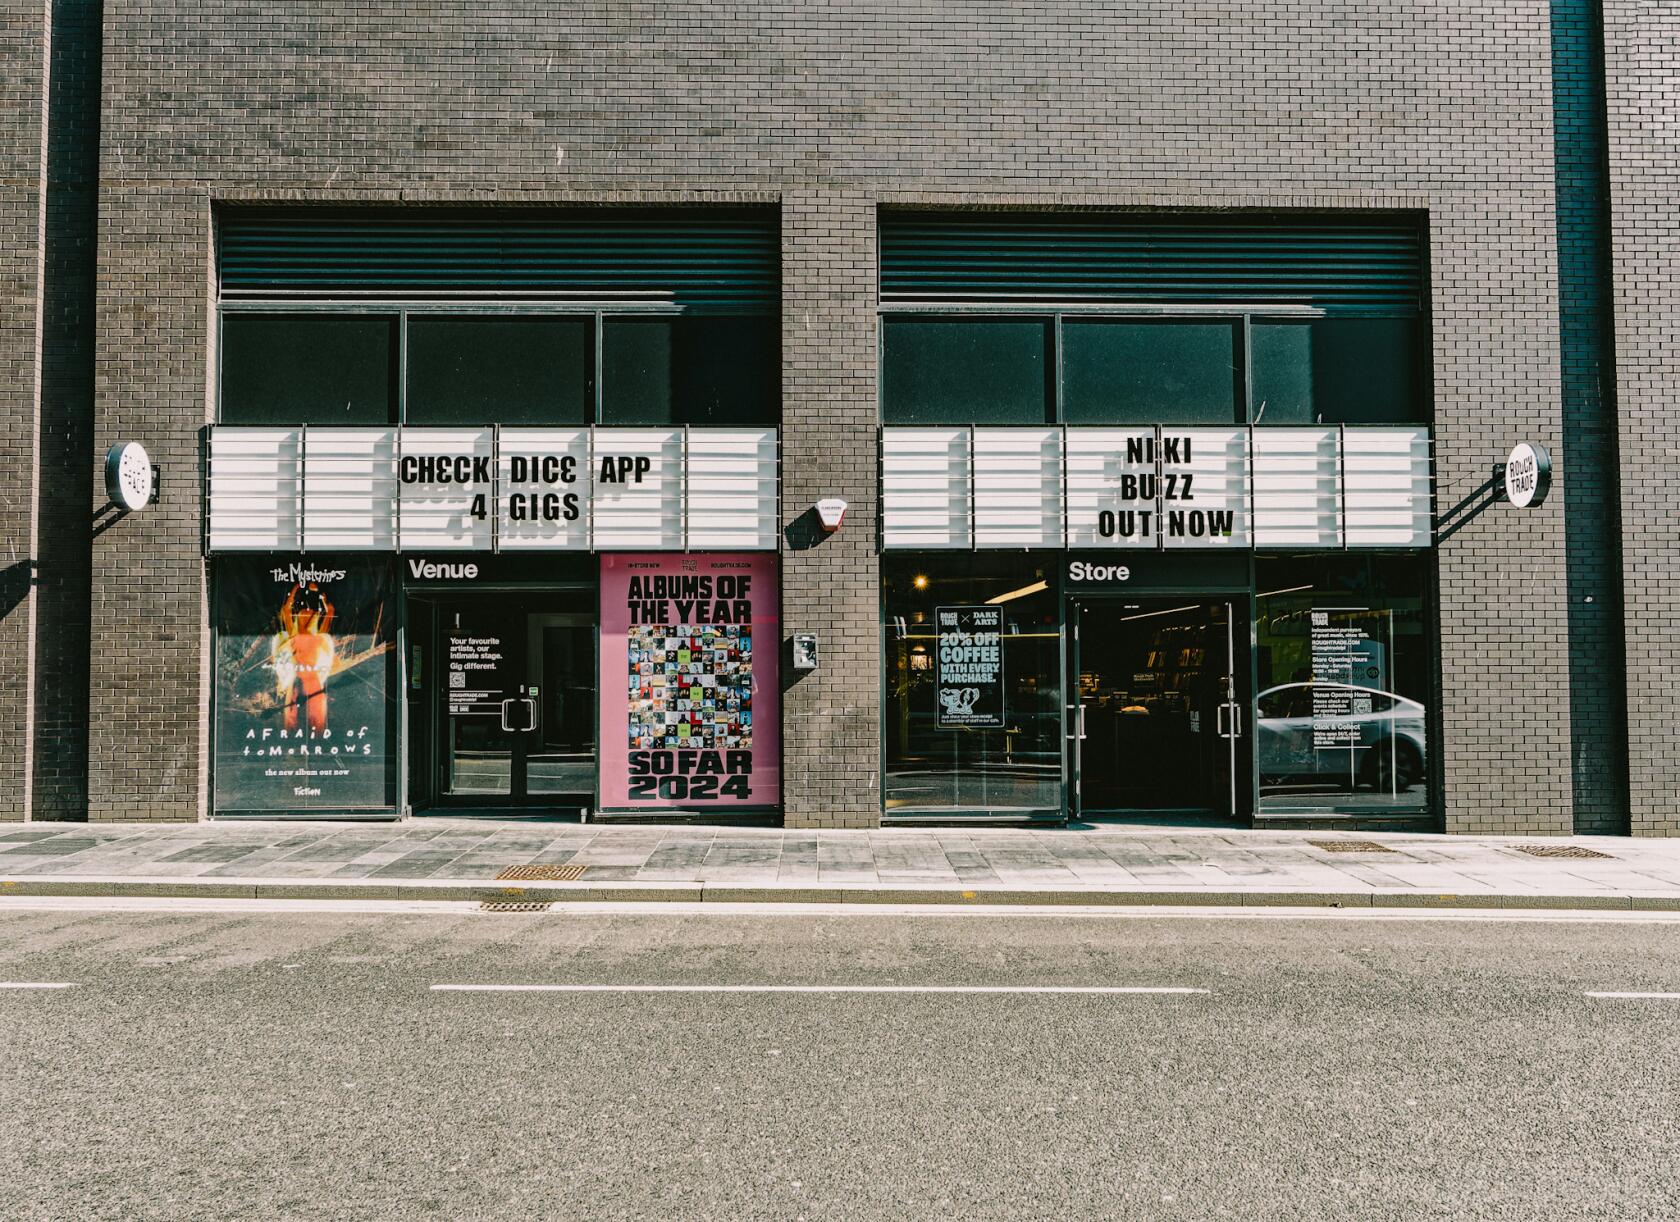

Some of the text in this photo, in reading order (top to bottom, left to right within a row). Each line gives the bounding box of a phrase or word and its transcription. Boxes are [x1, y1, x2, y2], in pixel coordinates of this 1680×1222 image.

[1127, 438, 1191, 463] NIKI
[401, 456, 650, 483] CHECK DICE APP
[1510, 455, 1533, 478] ROUGH
[1121, 474, 1194, 500] BUZZ
[1511, 474, 1534, 495] TRADE
[471, 493, 579, 520] 4 GIGS
[1099, 510, 1234, 537] OUT NOW
[409, 559, 478, 579] Venue
[1069, 561, 1130, 581] Store
[628, 575, 752, 599] ALBUMS OF
[628, 600, 752, 624] THE YEAR
[973, 611, 998, 619] DARK
[450, 637, 500, 645] Your favourite
[940, 632, 999, 646] 20% OFF
[940, 646, 999, 663] COFFEE
[464, 662, 497, 670] different.
[940, 663, 1000, 673] WITH EVERY
[941, 673, 996, 683] PURCHASE.
[628, 751, 752, 775] SO FAR
[628, 775, 752, 800] 2024
